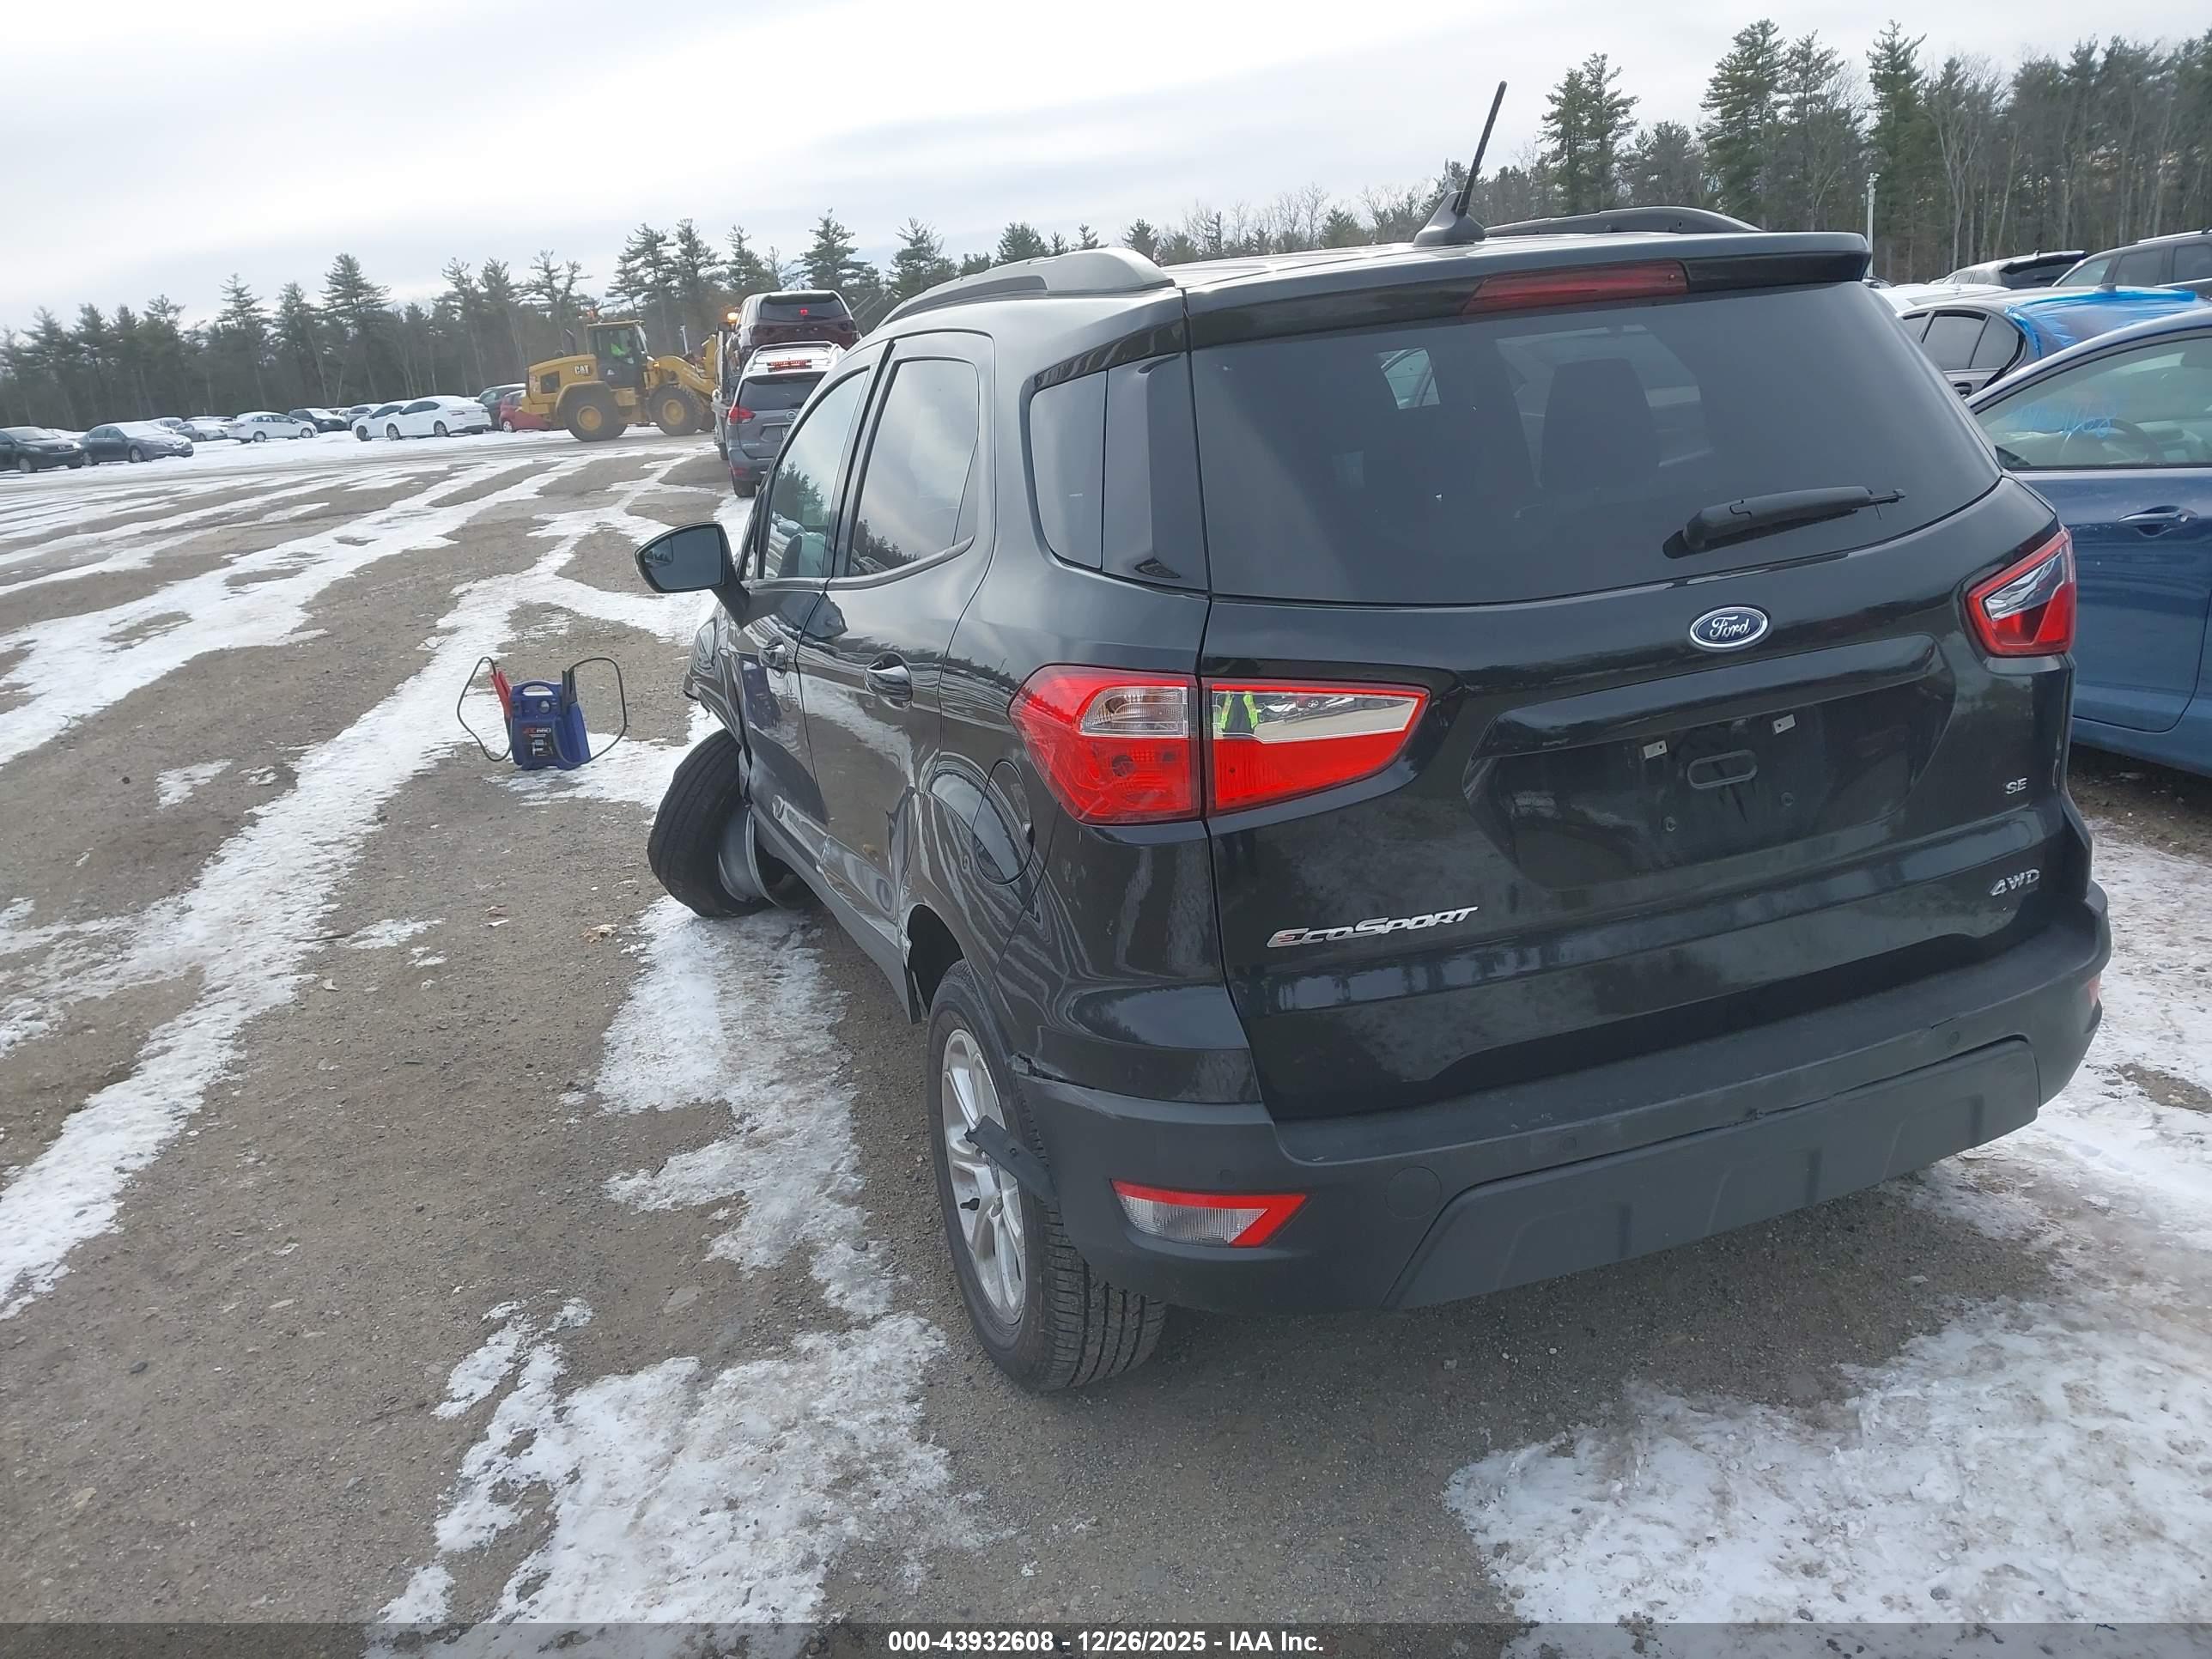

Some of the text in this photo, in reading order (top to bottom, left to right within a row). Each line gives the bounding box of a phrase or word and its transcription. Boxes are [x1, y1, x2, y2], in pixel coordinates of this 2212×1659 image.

[574, 365, 590, 375] CAT
[1710, 615, 1751, 640] Ford
[2005, 777, 2027, 794] SE
[1990, 869, 2040, 896] 4WD
